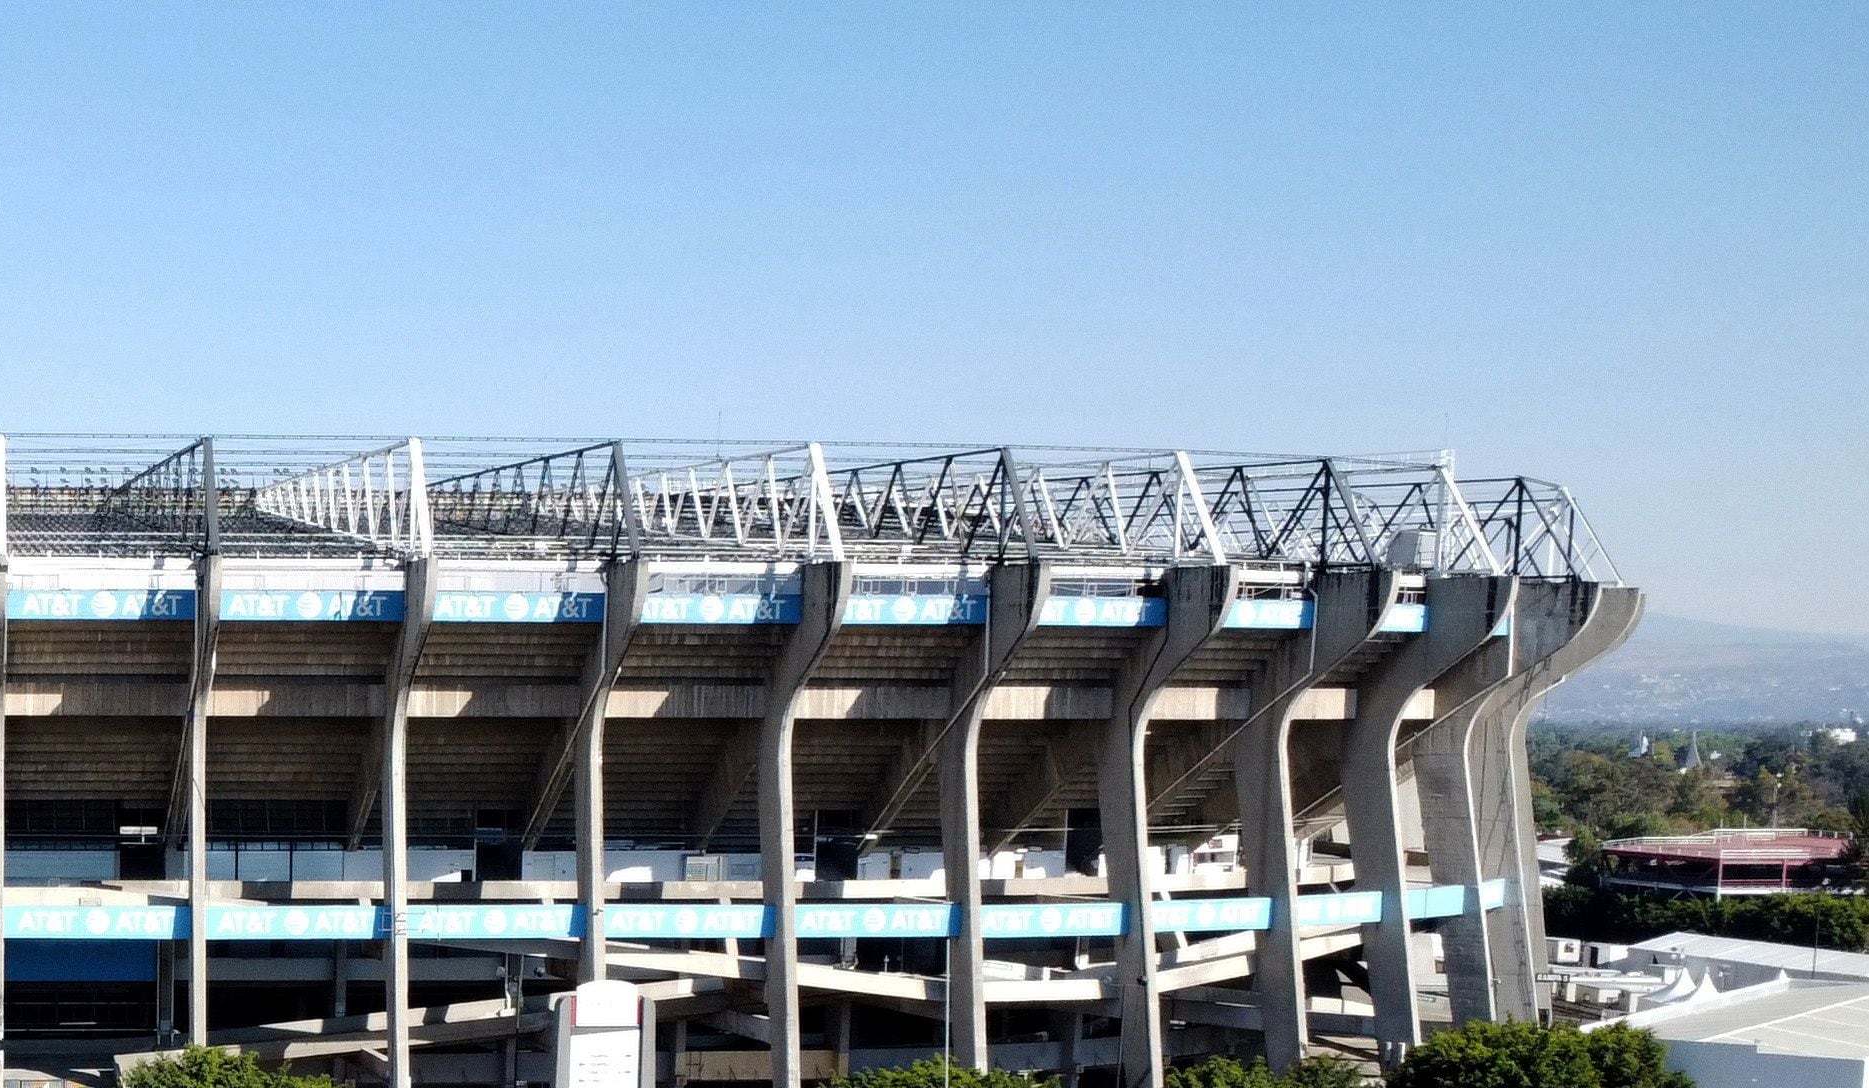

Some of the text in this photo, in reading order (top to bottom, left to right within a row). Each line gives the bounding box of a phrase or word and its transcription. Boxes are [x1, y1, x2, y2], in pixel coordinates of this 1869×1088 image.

[22, 594, 182, 616] AT&T AT&T
[229, 594, 387, 617] AT&T AT&T
[436, 596, 591, 619] AT&T AT&T
[729, 598, 785, 620] AT&T
[921, 598, 978, 621] AT&T
[19, 911, 174, 932] AT&T AT&T
[217, 912, 372, 933] AT&T AT&T
[419, 910, 570, 932] AT&T AT&T
[610, 910, 759, 932] AT&T AT&T
[800, 910, 947, 931] AT&T AT&T
[983, 911, 1034, 930] AT&T
